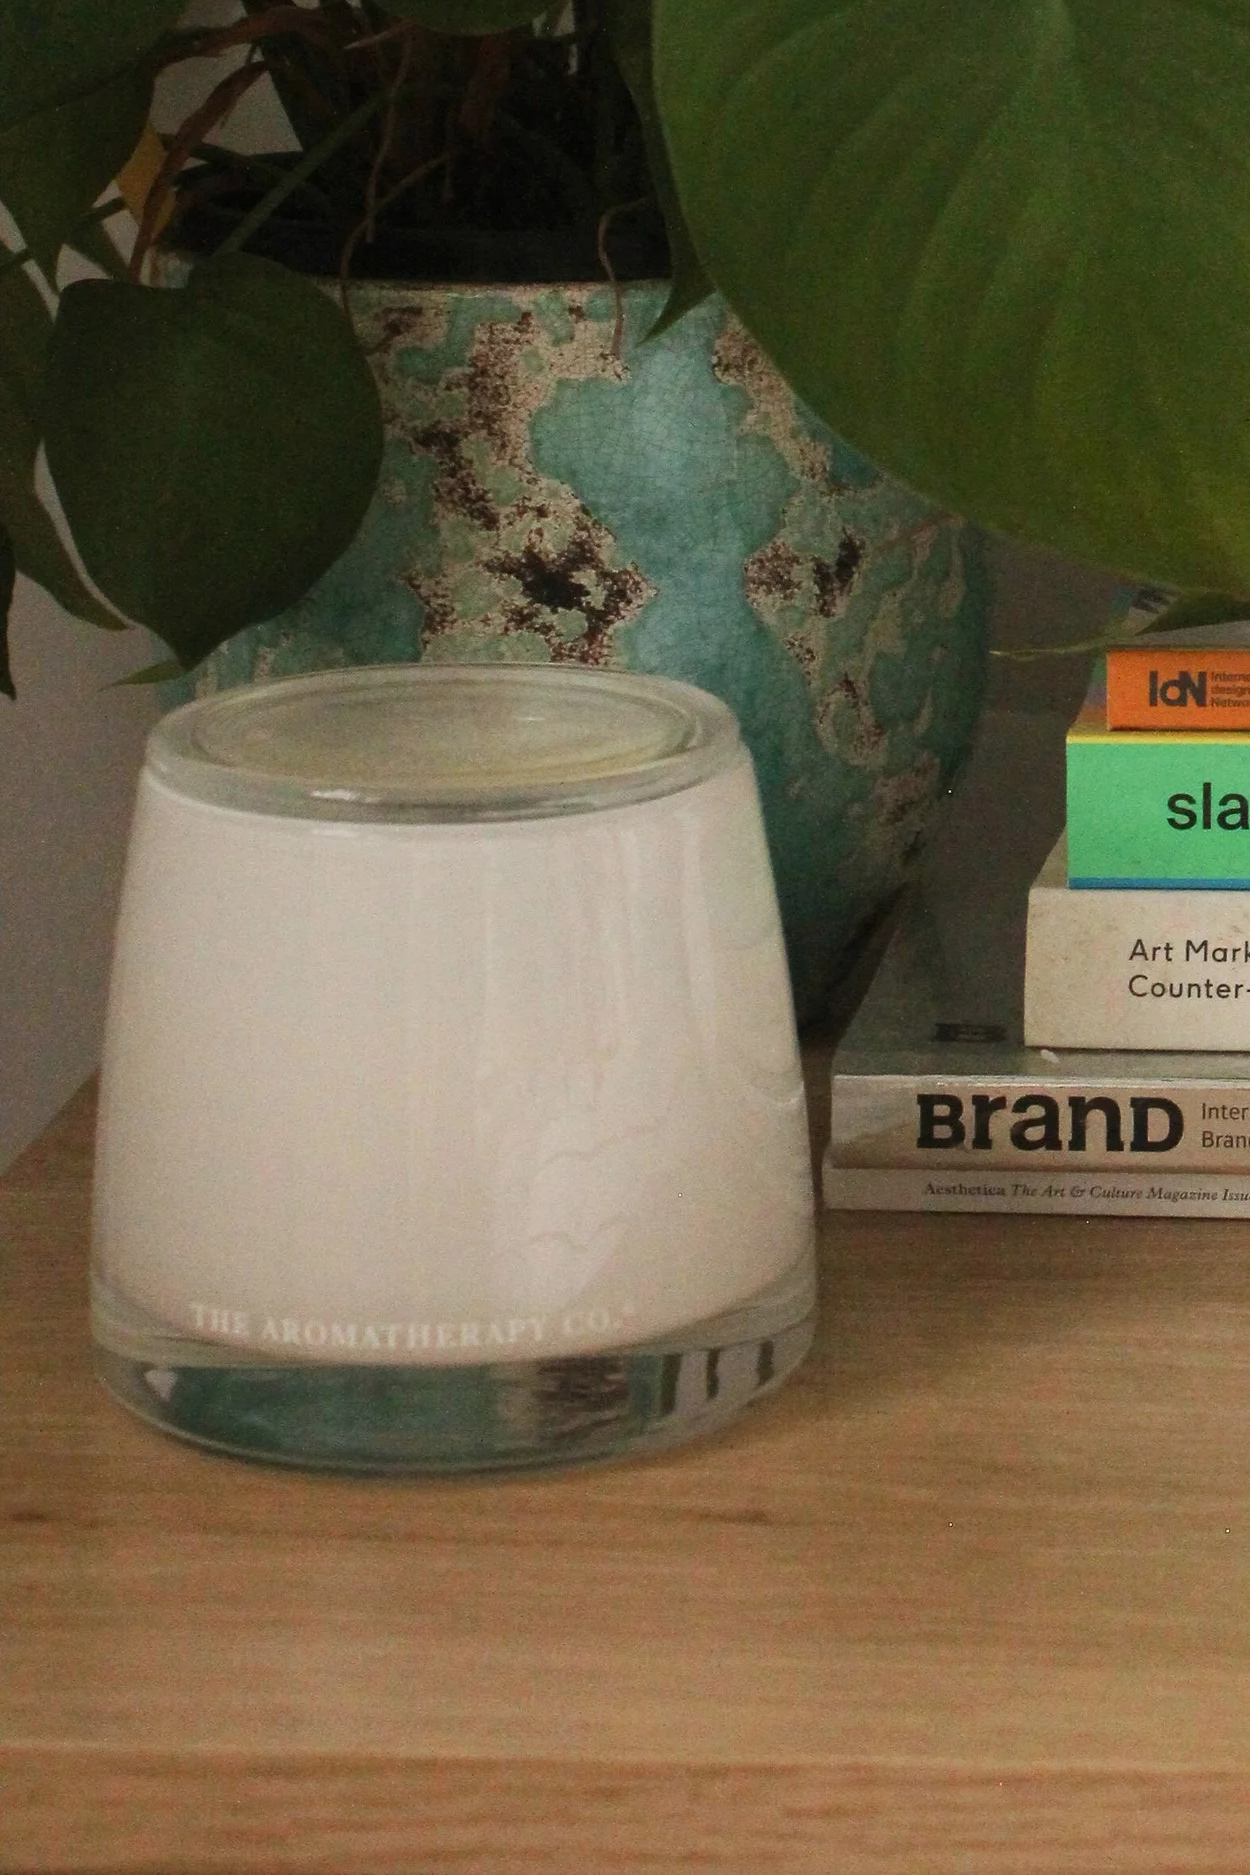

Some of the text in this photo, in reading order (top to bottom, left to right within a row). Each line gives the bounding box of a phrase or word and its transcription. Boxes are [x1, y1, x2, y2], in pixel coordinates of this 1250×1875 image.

[1128, 938, 1174, 962] Art
[924, 1182, 1006, 1198] Aesthetica
[1010, 1183, 1038, 1198] The
[1040, 1184, 1065, 1198] Art
[1089, 1185, 1143, 1200] Culture
[1145, 1186, 1218, 1204] Magazine
[189, 1301, 250, 1336] THE
[262, 1314, 548, 1350] AROMATHERAPY
